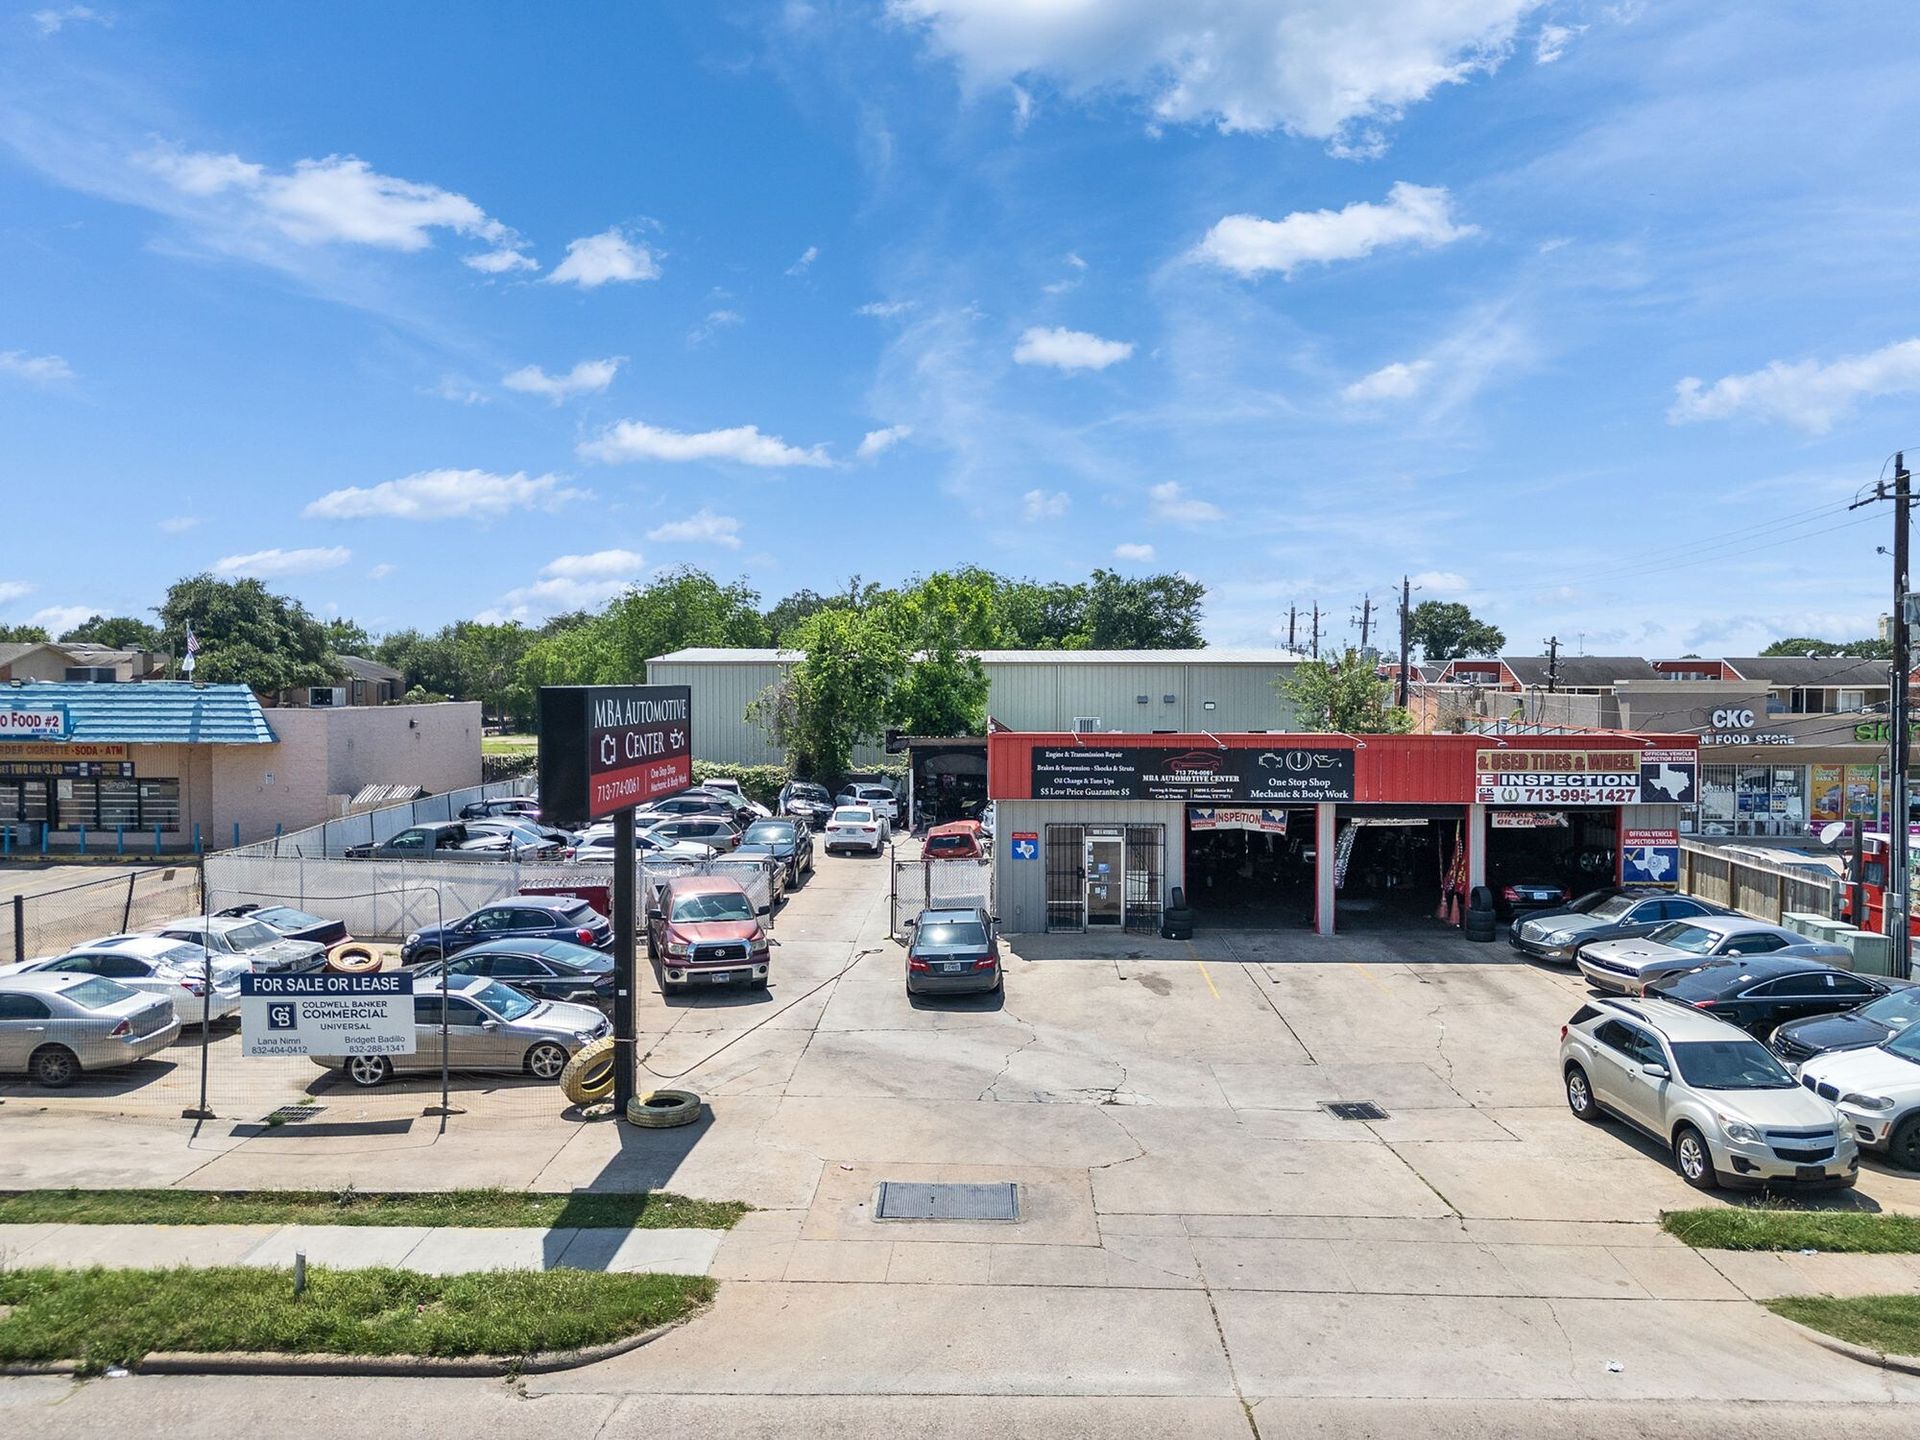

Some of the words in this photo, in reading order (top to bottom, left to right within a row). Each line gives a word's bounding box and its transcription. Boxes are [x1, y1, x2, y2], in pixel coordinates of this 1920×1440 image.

[594, 698, 622, 728] MBA
[624, 698, 687, 726] AUTOMOTIVE
[1712, 710, 1754, 728] CKC
[12, 712, 41, 728] FOOD
[45, 715, 59, 728] #2
[626, 732, 665, 759] CENTER
[1698, 736, 1709, 744] N
[1716, 734, 1750, 744] FOOD
[1756, 734, 1795, 744] STORE
[75, 746, 98, 755] SODA
[106, 746, 122, 754] ATM
[1492, 754, 1528, 770] USED
[1531, 754, 1572, 770] TIRES
[1574, 756, 1586, 770] &
[1587, 754, 1636, 770] WHEEL
[1268, 778, 1287, 786] One
[1288, 778, 1307, 788] Stop
[1308, 778, 1331, 788] Shop
[1502, 774, 1636, 786] INSPECTION
[598, 776, 640, 803] 713-774-0061
[1250, 790, 1291, 798] Mechanic
[1292, 790, 1300, 798] &
[1301, 790, 1324, 800] Body
[1325, 790, 1349, 798] Work
[1525, 788, 1636, 802] 713-995-1427
[1216, 812, 1261, 824] INSPETION
[253, 978, 282, 992] FOR
[286, 978, 324, 992] SALE
[327, 978, 350, 991] OR
[353, 978, 399, 991] LEASE
[302, 1010, 388, 1019] COMMERCIAL
[345, 1036, 376, 1045] Bridgett
